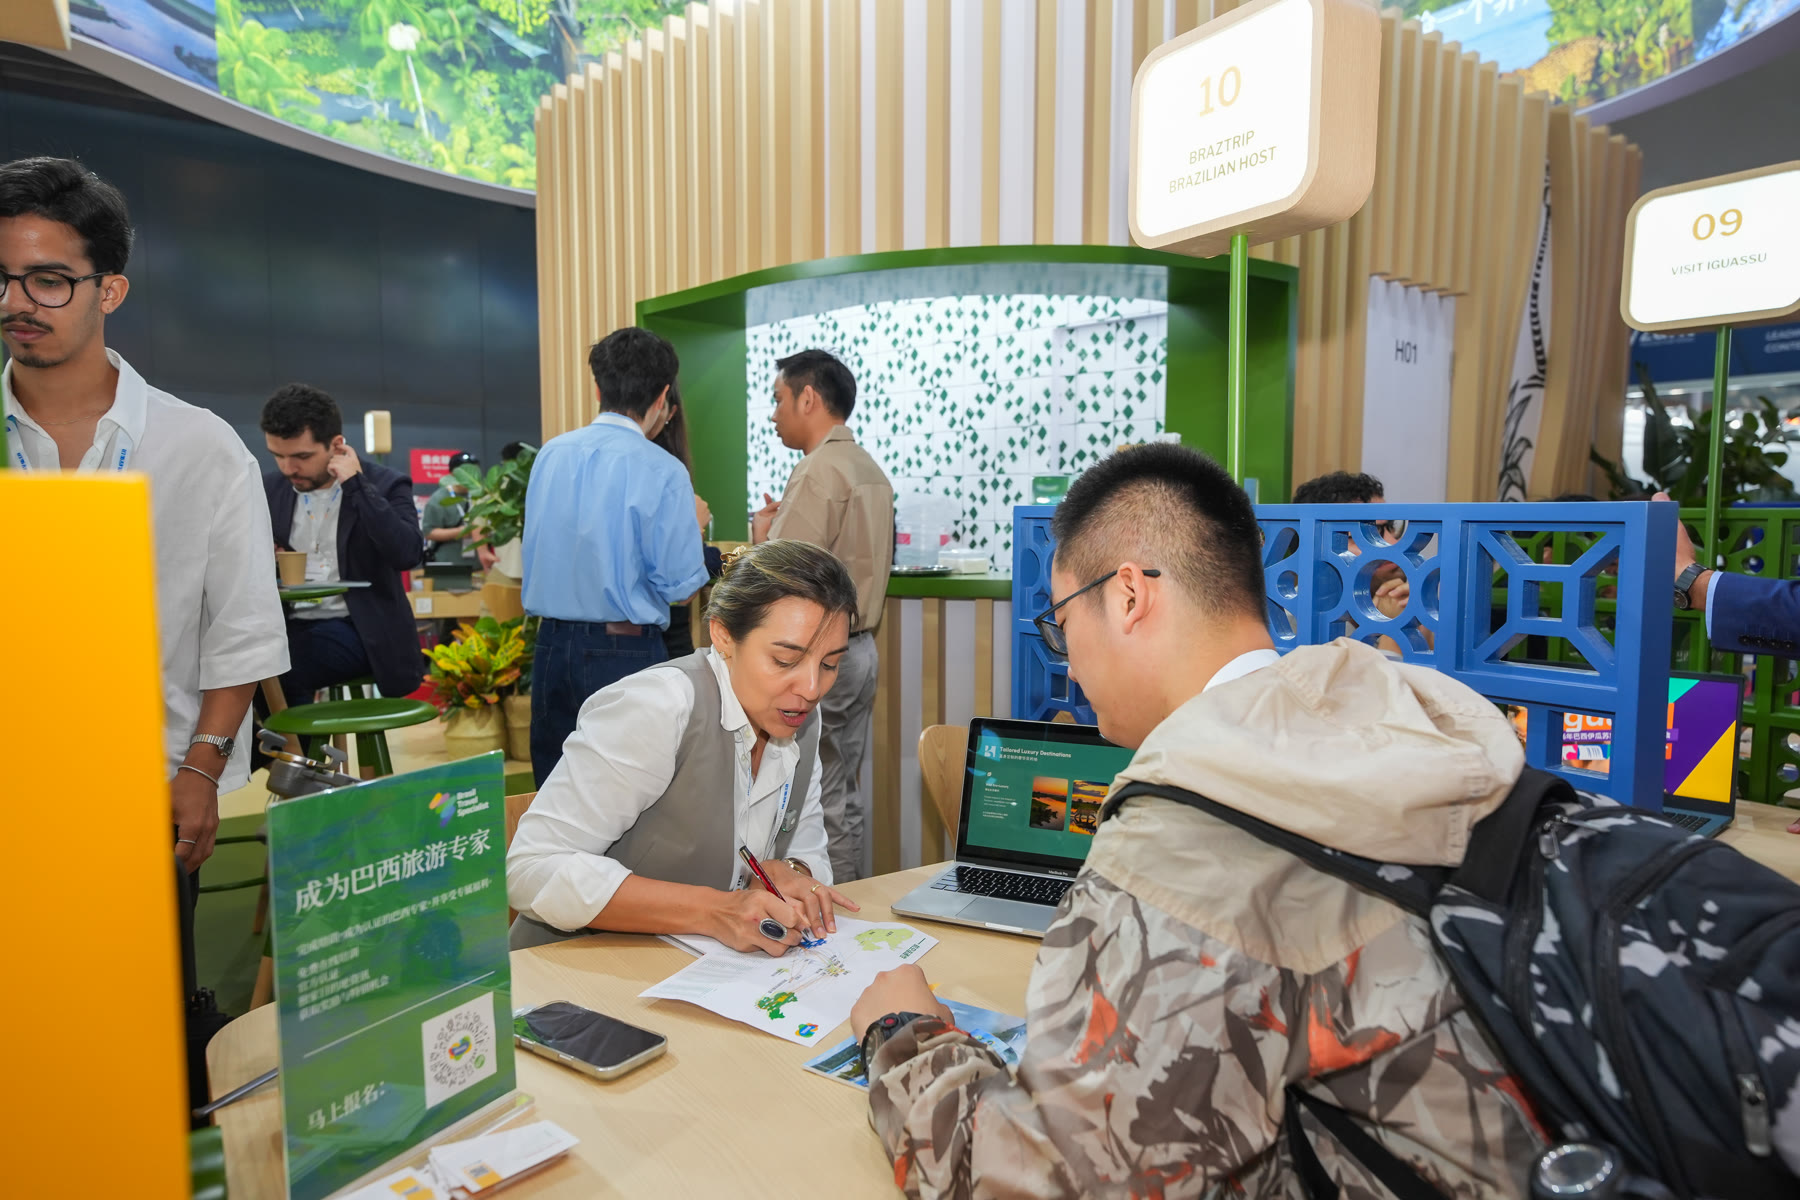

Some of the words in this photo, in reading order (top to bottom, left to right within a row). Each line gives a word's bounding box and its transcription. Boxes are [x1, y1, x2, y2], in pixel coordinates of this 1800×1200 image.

[1198, 66, 1242, 117] 10
[1189, 130, 1255, 165] BRAZTRIP
[1169, 159, 1236, 193] BRAZILIAN
[1239, 146, 1277, 171] HOST
[1692, 208, 1743, 240] 09
[1671, 262, 1704, 276] VISIT
[1707, 252, 1768, 271] IGUASSU
[1395, 339, 1417, 365] H01
[999, 746, 1020, 754] Tailored
[1021, 748, 1039, 756] Luxury
[1039, 750, 1072, 758] Destinations
[457, 796, 479, 809] Travel
[457, 801, 490, 818] Specialist
[295, 828, 491, 916] 成为巴西旅游专家
